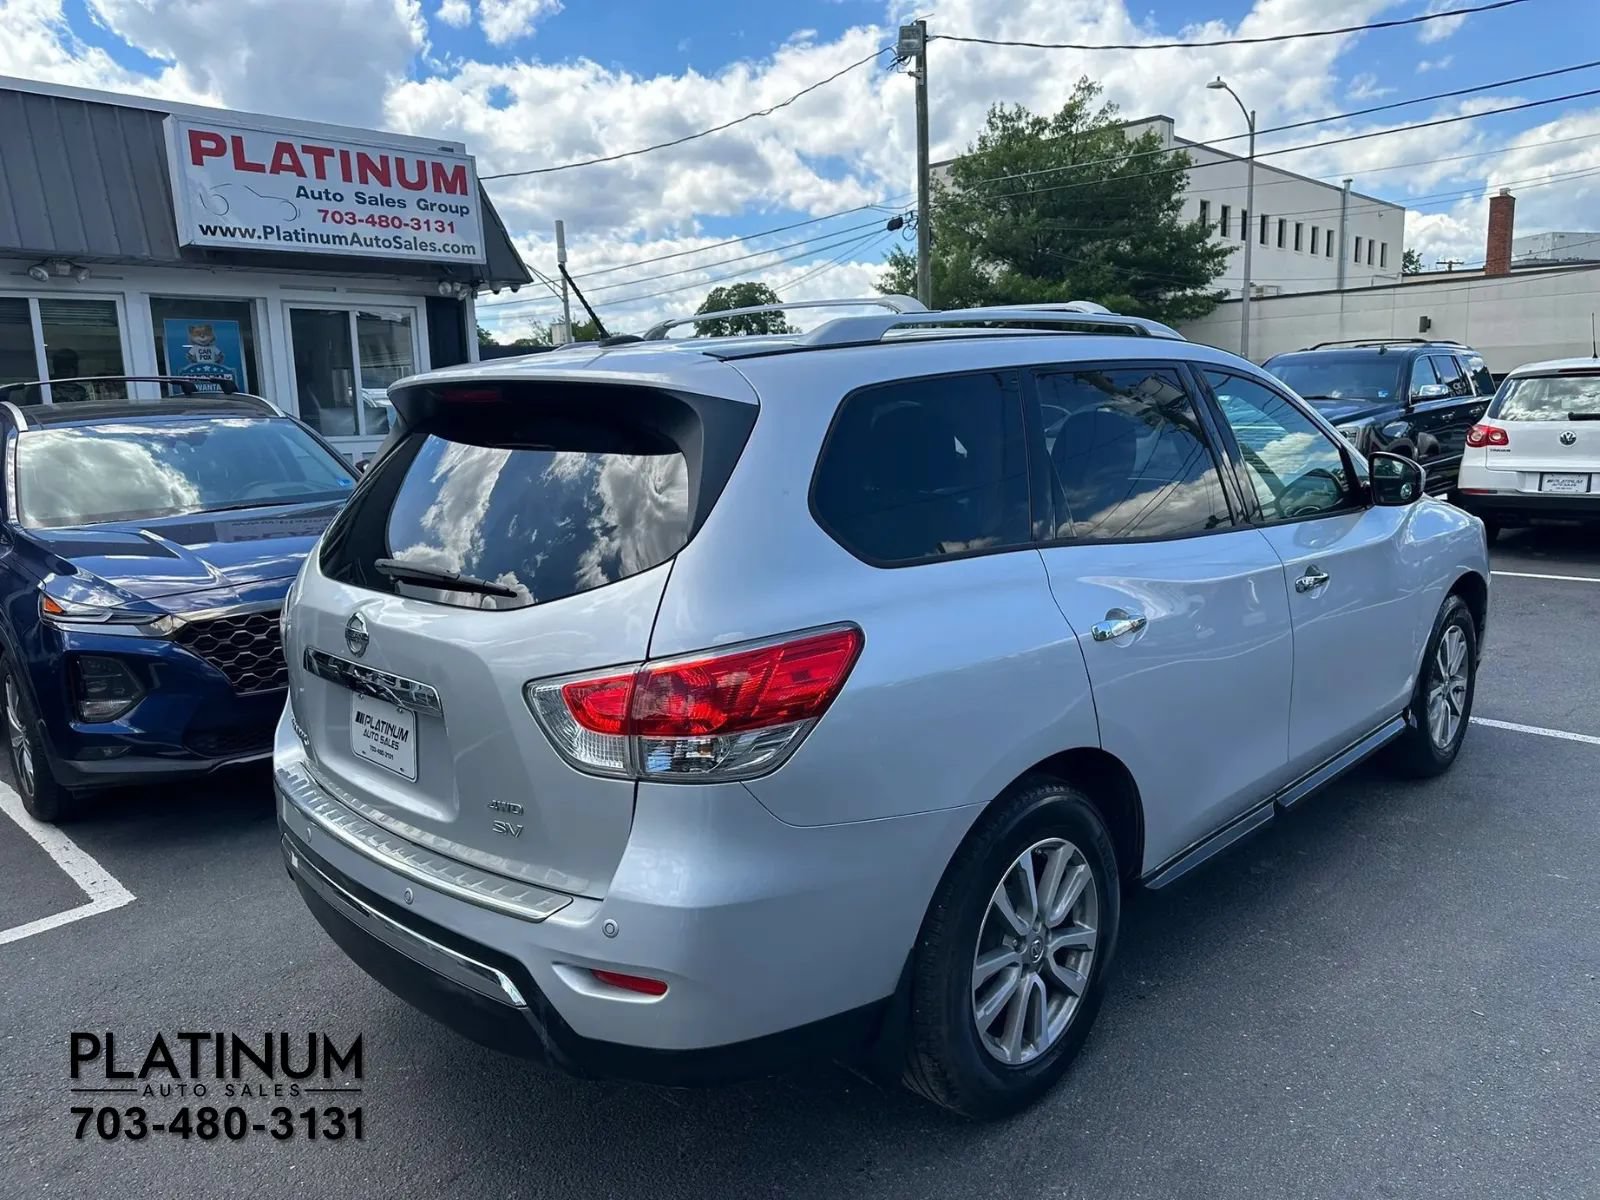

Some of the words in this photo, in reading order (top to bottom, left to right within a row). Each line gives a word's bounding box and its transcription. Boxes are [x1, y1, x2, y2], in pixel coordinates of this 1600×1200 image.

[188, 129, 469, 196] PLATINUM
[295, 185, 344, 204] Auto
[354, 192, 407, 209] Sales
[416, 199, 470, 216] Group
[317, 209, 455, 234] 703-480-3131
[198, 224, 476, 255] www.PlatinumAutoSales.com
[363, 728, 379, 742] AUTO
[380, 735, 400, 750] SALES
[364, 715, 409, 743] PLATINUM
[492, 820, 523, 838] SV
